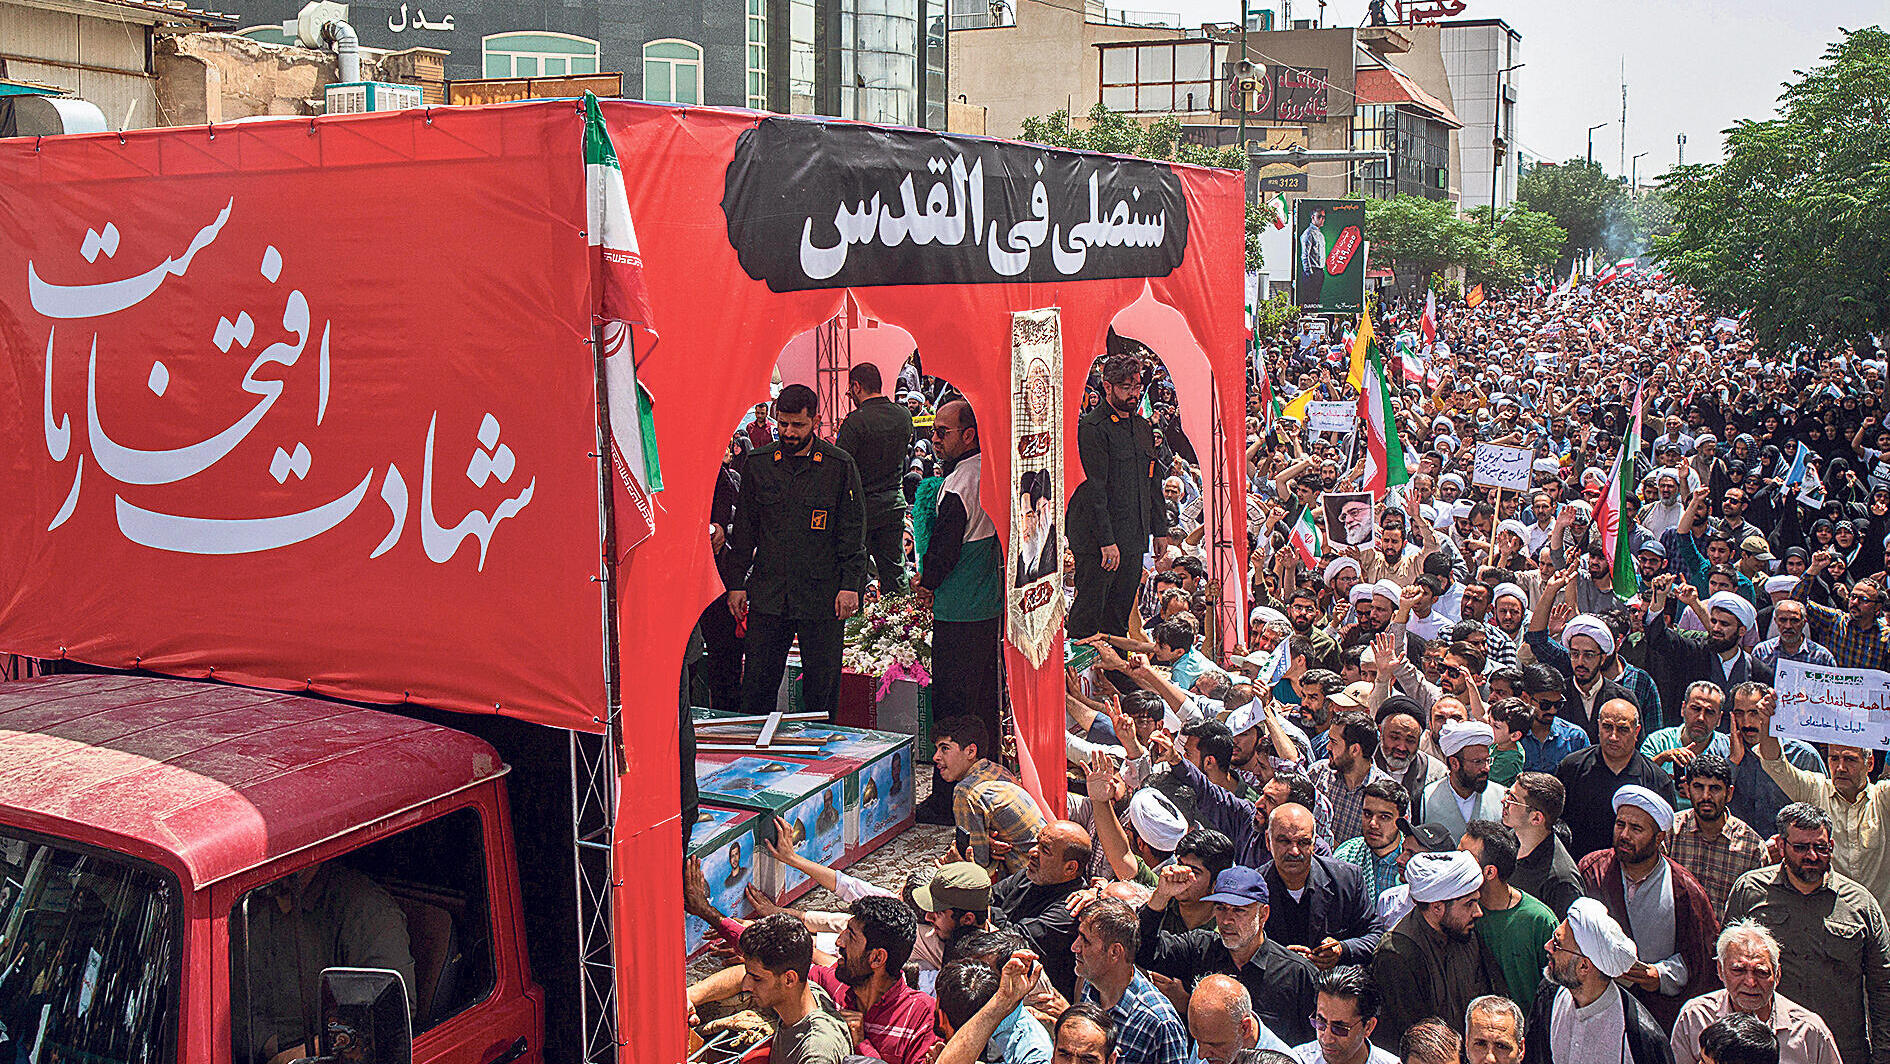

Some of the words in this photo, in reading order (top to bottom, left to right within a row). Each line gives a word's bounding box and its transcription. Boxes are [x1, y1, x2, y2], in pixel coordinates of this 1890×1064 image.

[388, 2, 455, 33] عدل
[799, 152, 985, 281] القدس
[1279, 178, 1299, 188] 3123
[47, 244, 332, 532] افتخار
[115, 410, 536, 572] شهادت
